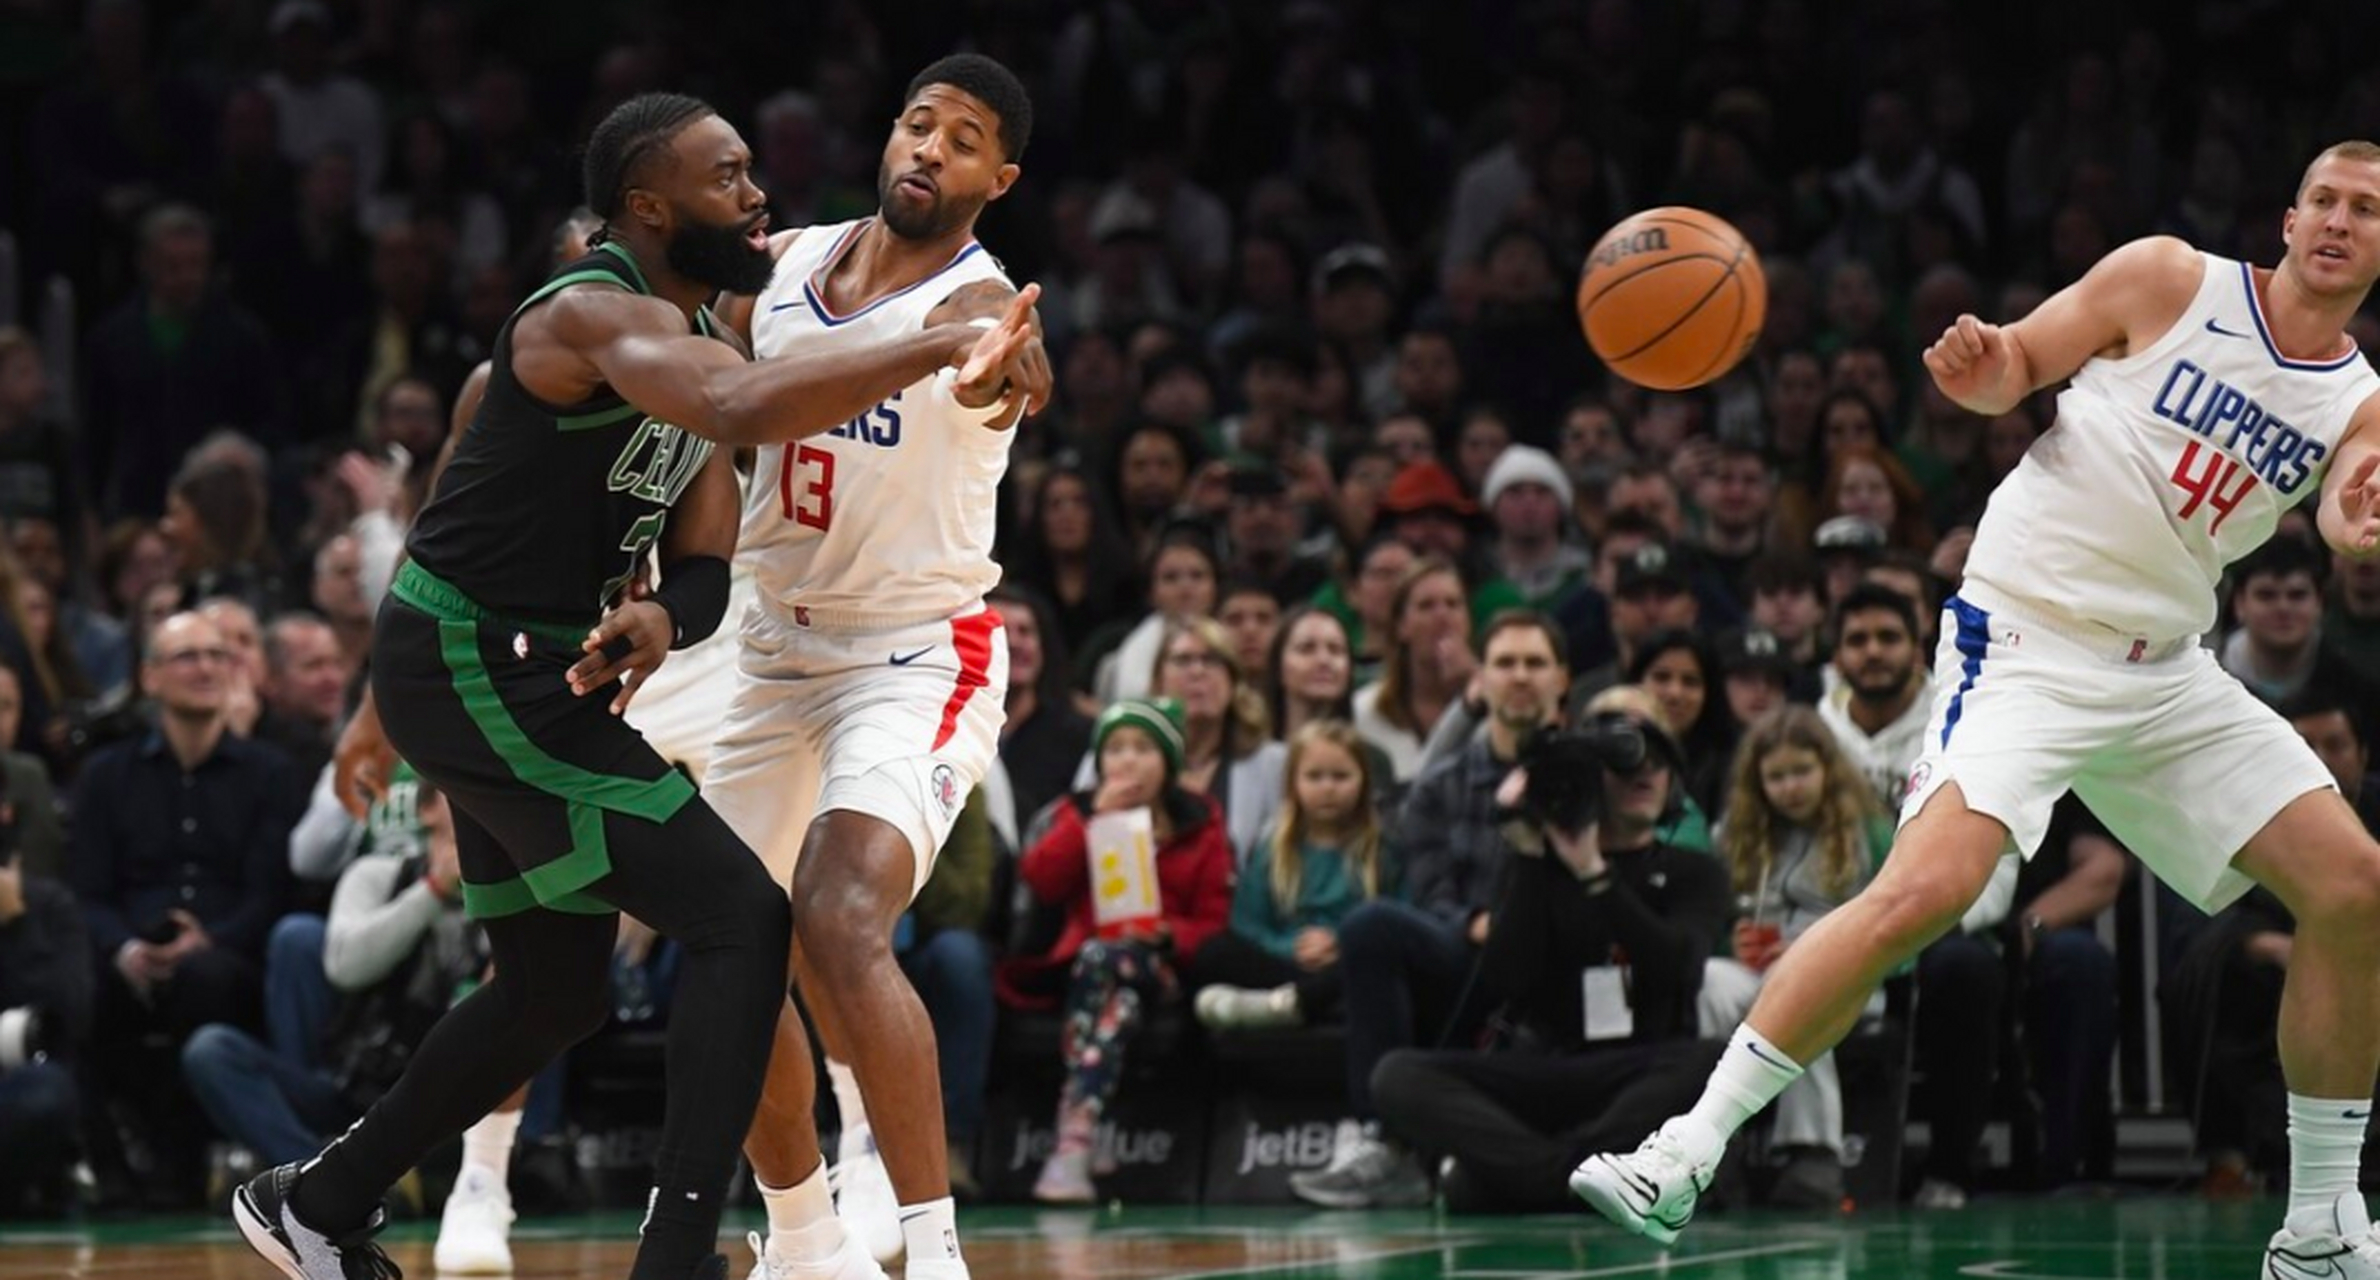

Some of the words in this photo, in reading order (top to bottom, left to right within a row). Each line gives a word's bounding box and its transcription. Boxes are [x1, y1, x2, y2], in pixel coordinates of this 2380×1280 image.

[2152, 358, 2327, 496] CLIPPERS
[780, 441, 834, 532] 13
[2170, 439, 2259, 537] 44
[1008, 1119, 1172, 1171] jelue
[1237, 1120, 1337, 1175] jetB
